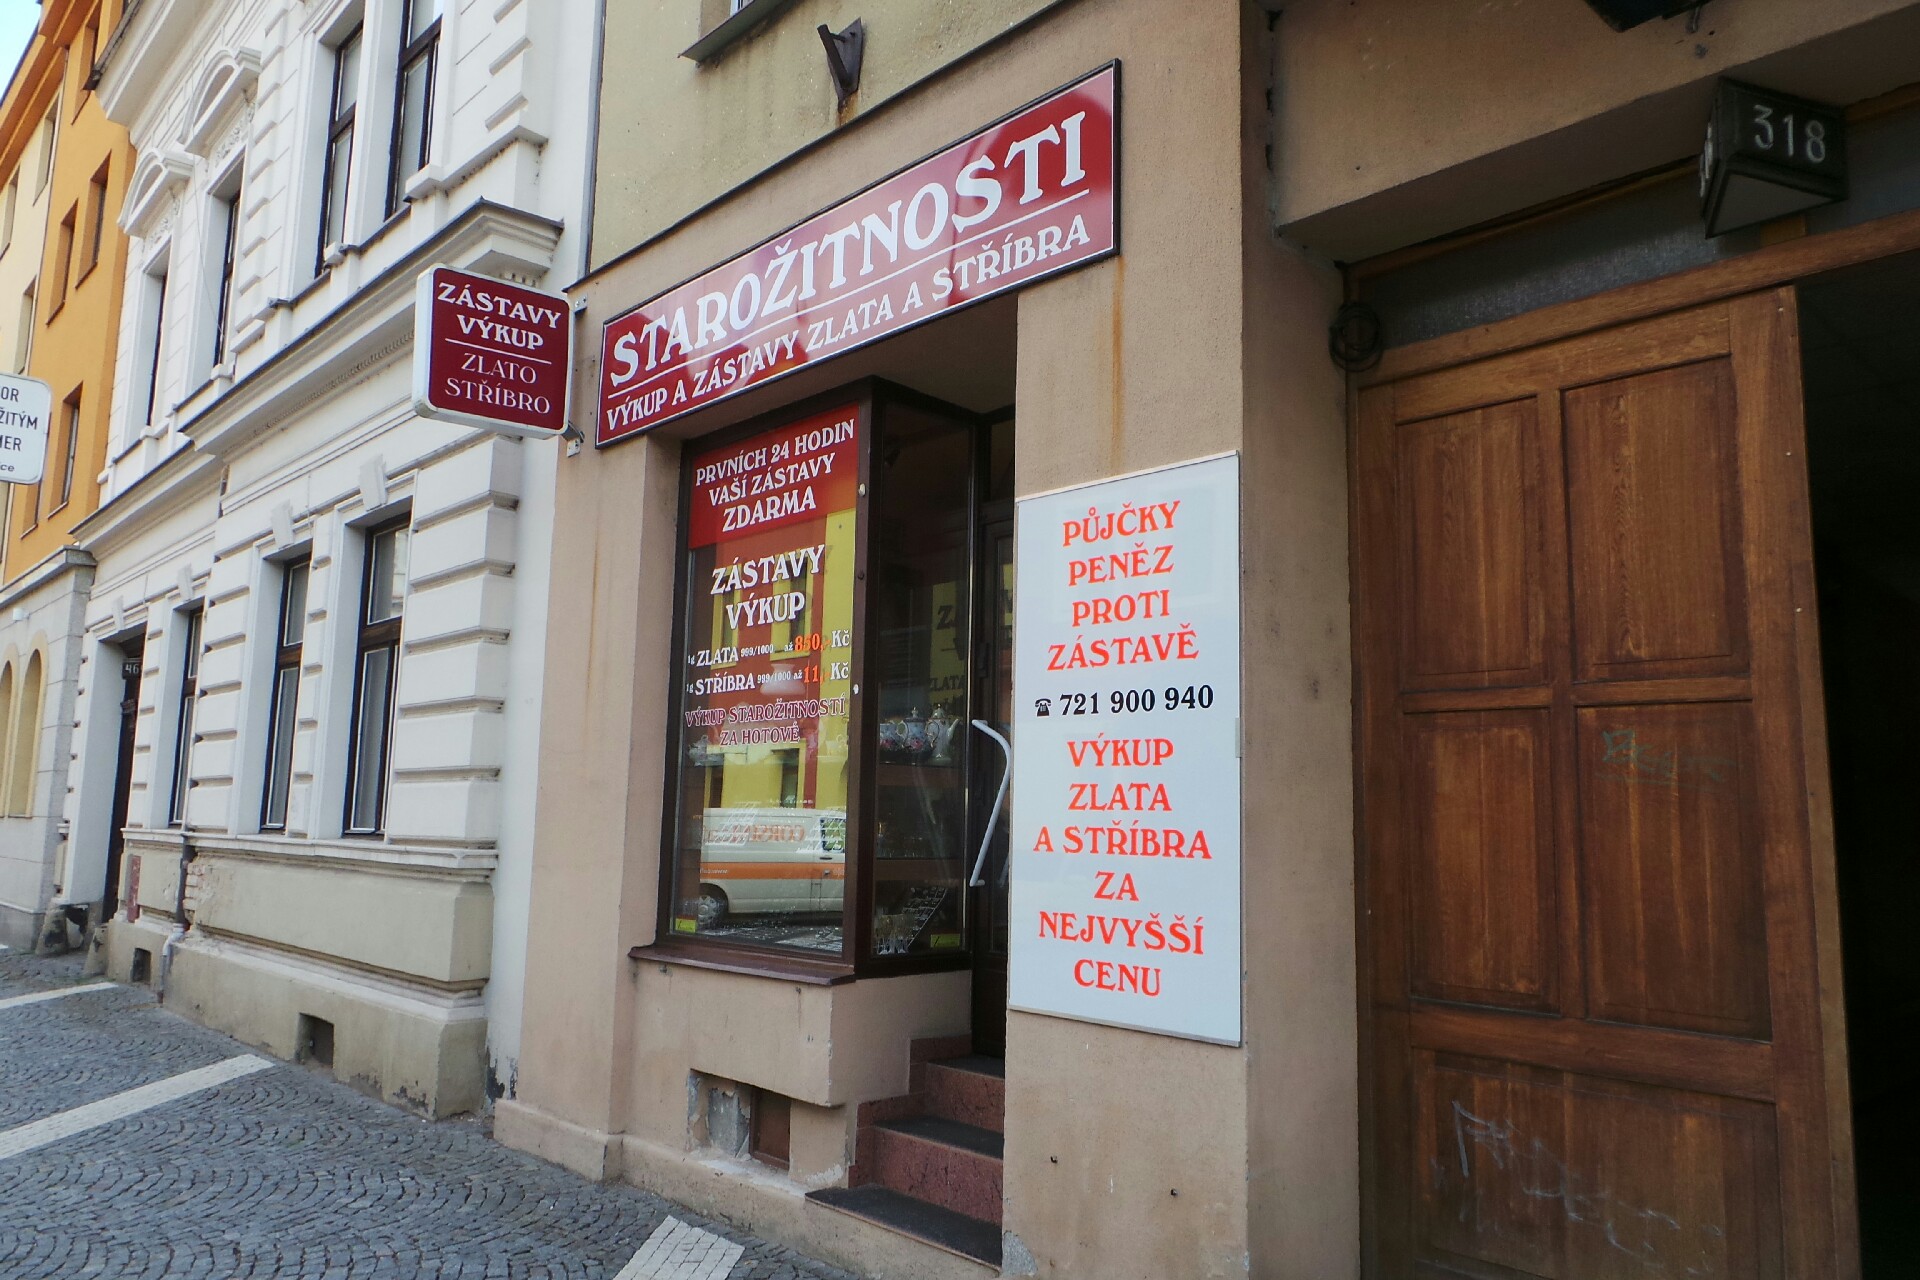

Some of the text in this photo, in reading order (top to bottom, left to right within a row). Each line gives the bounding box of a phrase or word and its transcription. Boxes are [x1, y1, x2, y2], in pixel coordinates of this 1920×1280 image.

[1752, 104, 1826, 164] 318
[610, 111, 1086, 387] STAROŽITNOSTI
[437, 282, 562, 329] ZÁSTAVY
[607, 214, 1090, 430] VÝKUP A ZÁSTAVY ZLATA A STŘÍBRA
[456, 314, 544, 350] VÝKUP
[461, 352, 537, 384] ZLATO
[444, 377, 550, 414] STŘÍBRO
[695, 418, 855, 486] PRVNÍCH 24 HODIN
[708, 452, 836, 506] VAŠÍ ZÁSTAVY
[722, 485, 816, 532] ZDARMA
[1062, 500, 1181, 547] PŮJČKY
[710, 544, 825, 595] ZÁSTAVY
[1068, 541, 1174, 587] PENĚZ
[725, 592, 805, 630] VÝKUP
[1072, 589, 1170, 627] PROTI
[696, 647, 739, 667] ZLATA
[784, 642, 794, 652] až
[831, 629, 850, 648] Kč
[1047, 622, 1199, 671] ZÁSTAVĚ
[695, 671, 756, 695] STŘÍBRA
[793, 669, 803, 680] až
[830, 661, 849, 680] Kč
[685, 693, 846, 727] VÝKUP STAROŽITNOSTÍ
[1059, 684, 1214, 716] 721 900 940
[720, 731, 738, 747] ZA
[1066, 732, 1174, 768] VÝKUP
[1067, 783, 1172, 811] ZLATA
[1033, 819, 1212, 860] A STŘÍBRA
[1093, 870, 1139, 901] ZA
[1038, 911, 1204, 955] NEJVYŠŠÍ
[1073, 959, 1161, 997] CENU
